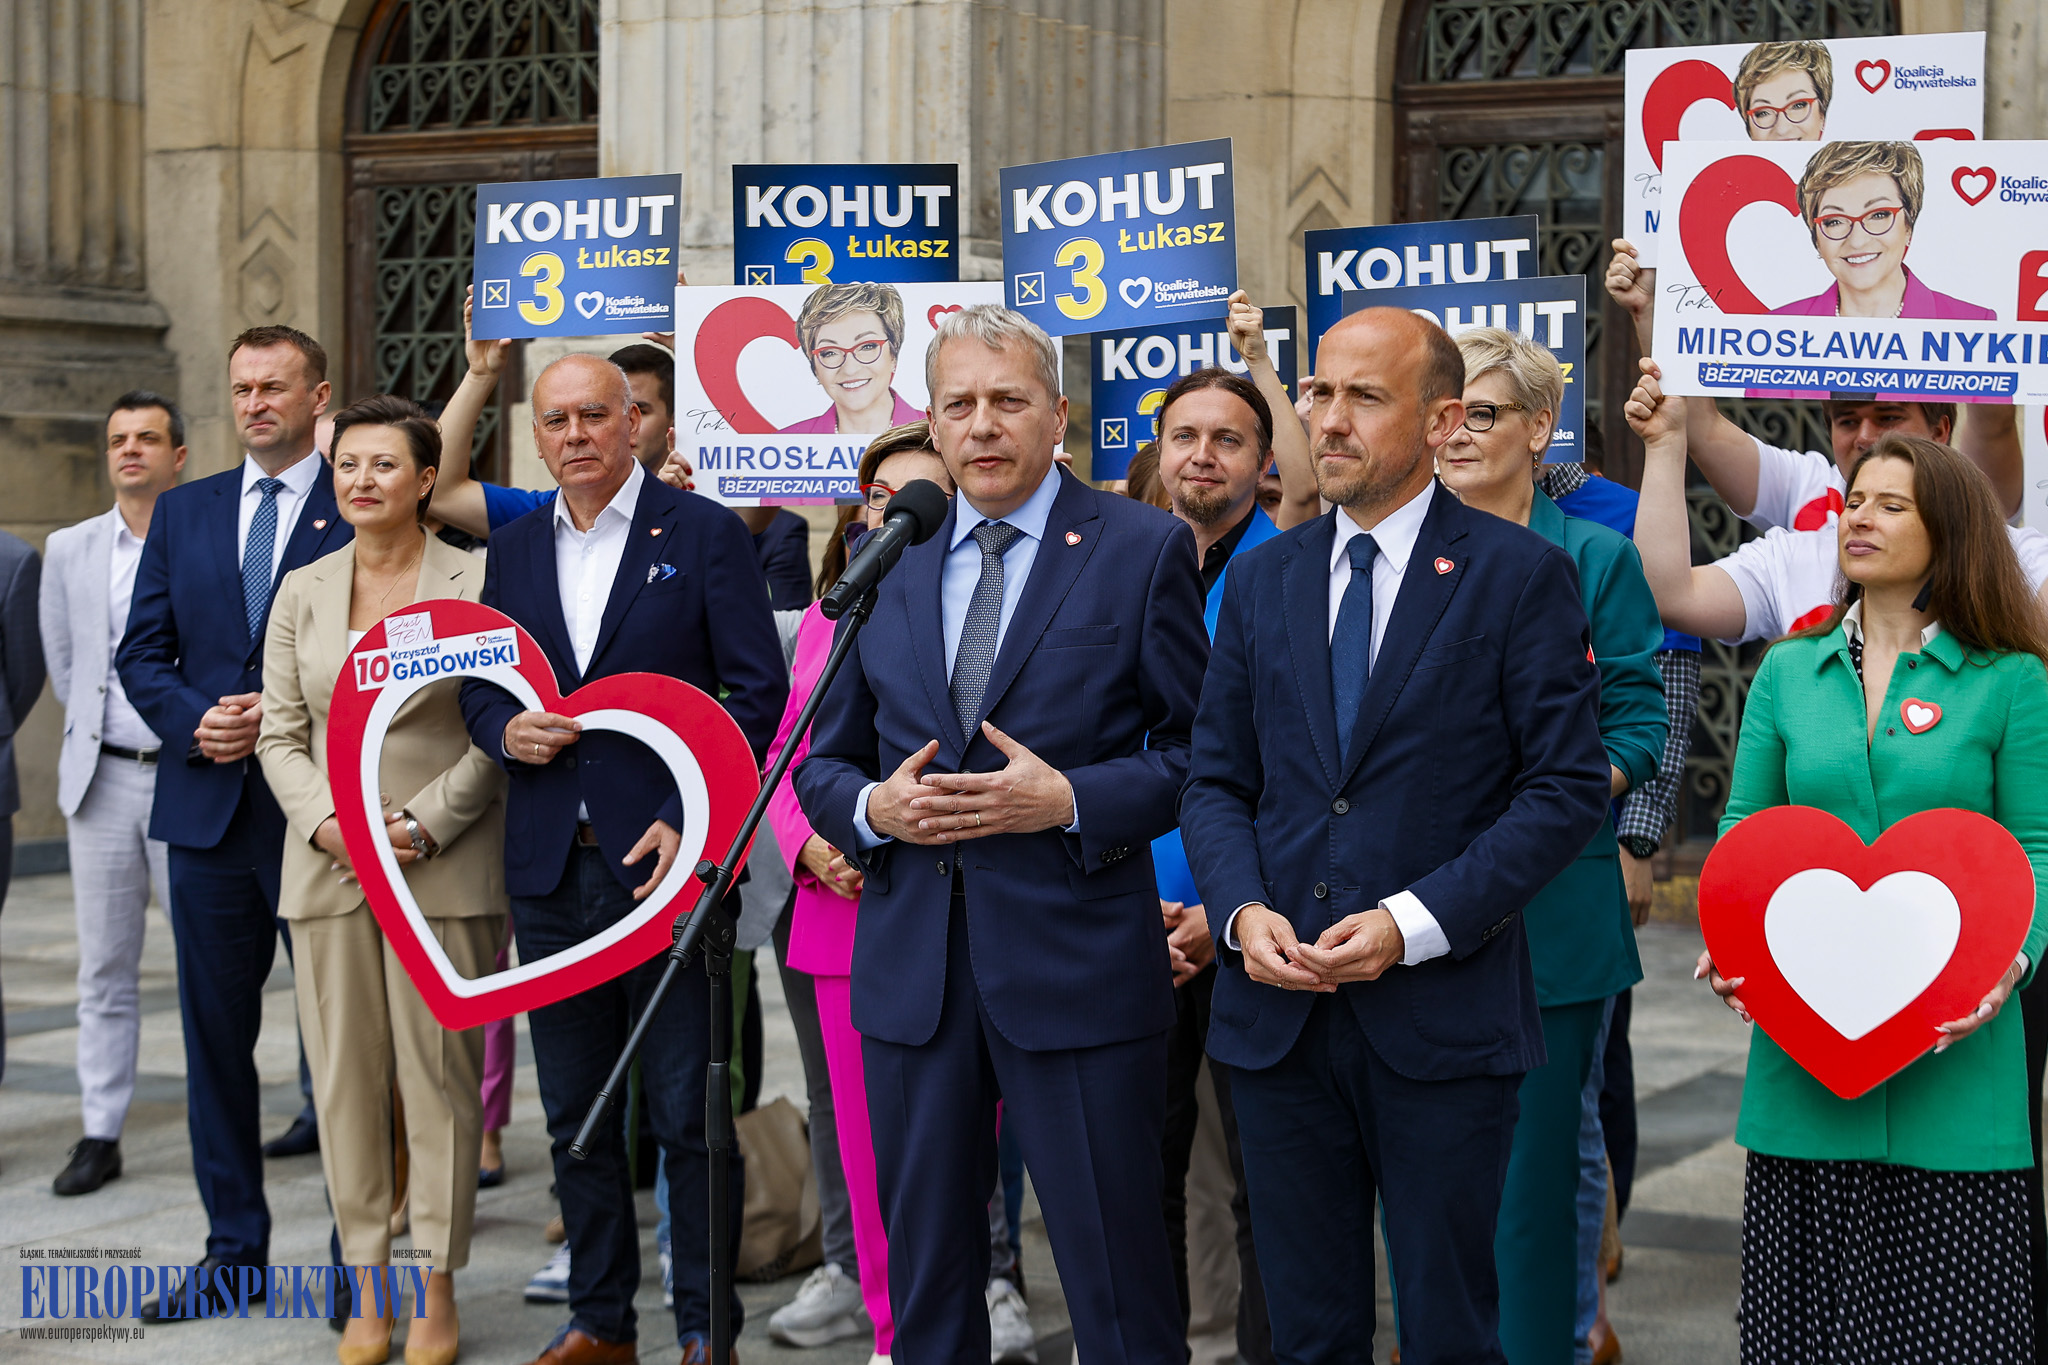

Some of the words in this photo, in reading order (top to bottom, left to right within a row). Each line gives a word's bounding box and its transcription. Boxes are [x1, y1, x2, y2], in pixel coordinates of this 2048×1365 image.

[1894, 75, 1976, 91] Obywatelska
[1895, 65, 1944, 78] Koalicja
[745, 185, 952, 228] KOHUT
[1012, 162, 1225, 234] KOHUT
[486, 194, 675, 244] KOHUT
[847, 234, 949, 258] Łukasz
[1118, 222, 1225, 253] Łukasz
[577, 245, 671, 269] Łukasz
[1318, 239, 1530, 295] KOHUT
[518, 251, 565, 326] 3
[1054, 237, 1107, 320] 3
[1154, 279, 1199, 293] Koalicja
[605, 296, 645, 308] Koalicja
[1154, 285, 1229, 304] Obywatelska
[1667, 284, 1723, 314] Tak!
[605, 304, 670, 317] Obywatelska
[1677, 327, 1908, 361] MIROSŁAWA
[1704, 367, 1819, 387] BEZPIECZNA
[1823, 370, 1899, 389] POLSKA
[1904, 372, 1924, 389] W
[1924, 373, 2012, 392] EUROPIE
[686, 409, 736, 435] Tak!
[724, 480, 824, 494] BEZPIECZNA
[357, 654, 390, 685] 10
[393, 644, 515, 680] GADOWSKI
[390, 643, 440, 661] Krzysztof
